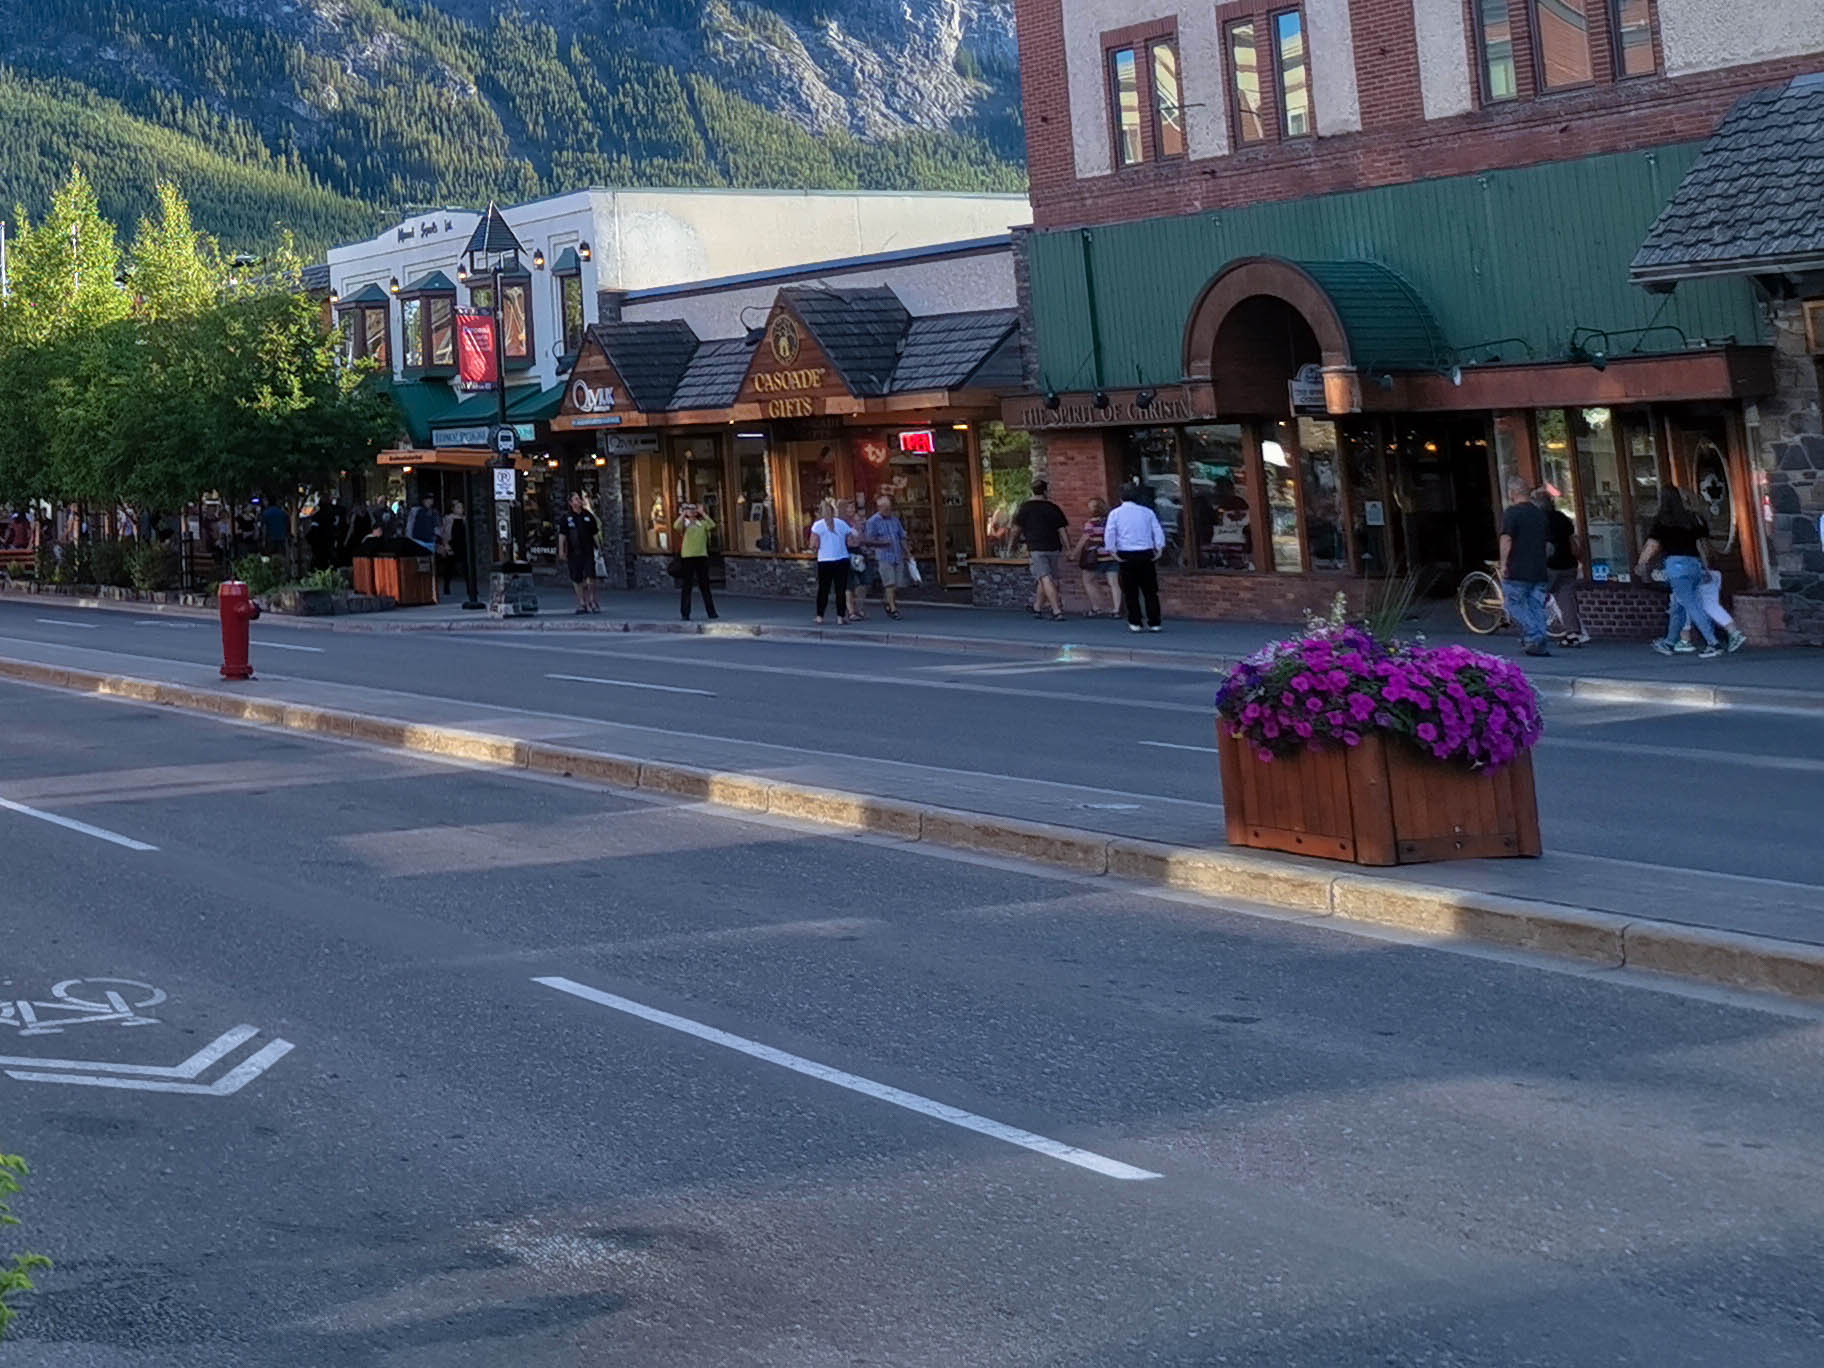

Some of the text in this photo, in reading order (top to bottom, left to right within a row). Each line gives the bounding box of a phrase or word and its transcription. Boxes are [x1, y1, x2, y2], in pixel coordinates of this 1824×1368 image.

[754, 369, 822, 392] CASCADE
[769, 397, 812, 418] GIFTS
[1022, 407, 1046, 425] THE
[1050, 404, 1095, 424] SPIRIT
[1101, 403, 1122, 422] OF
